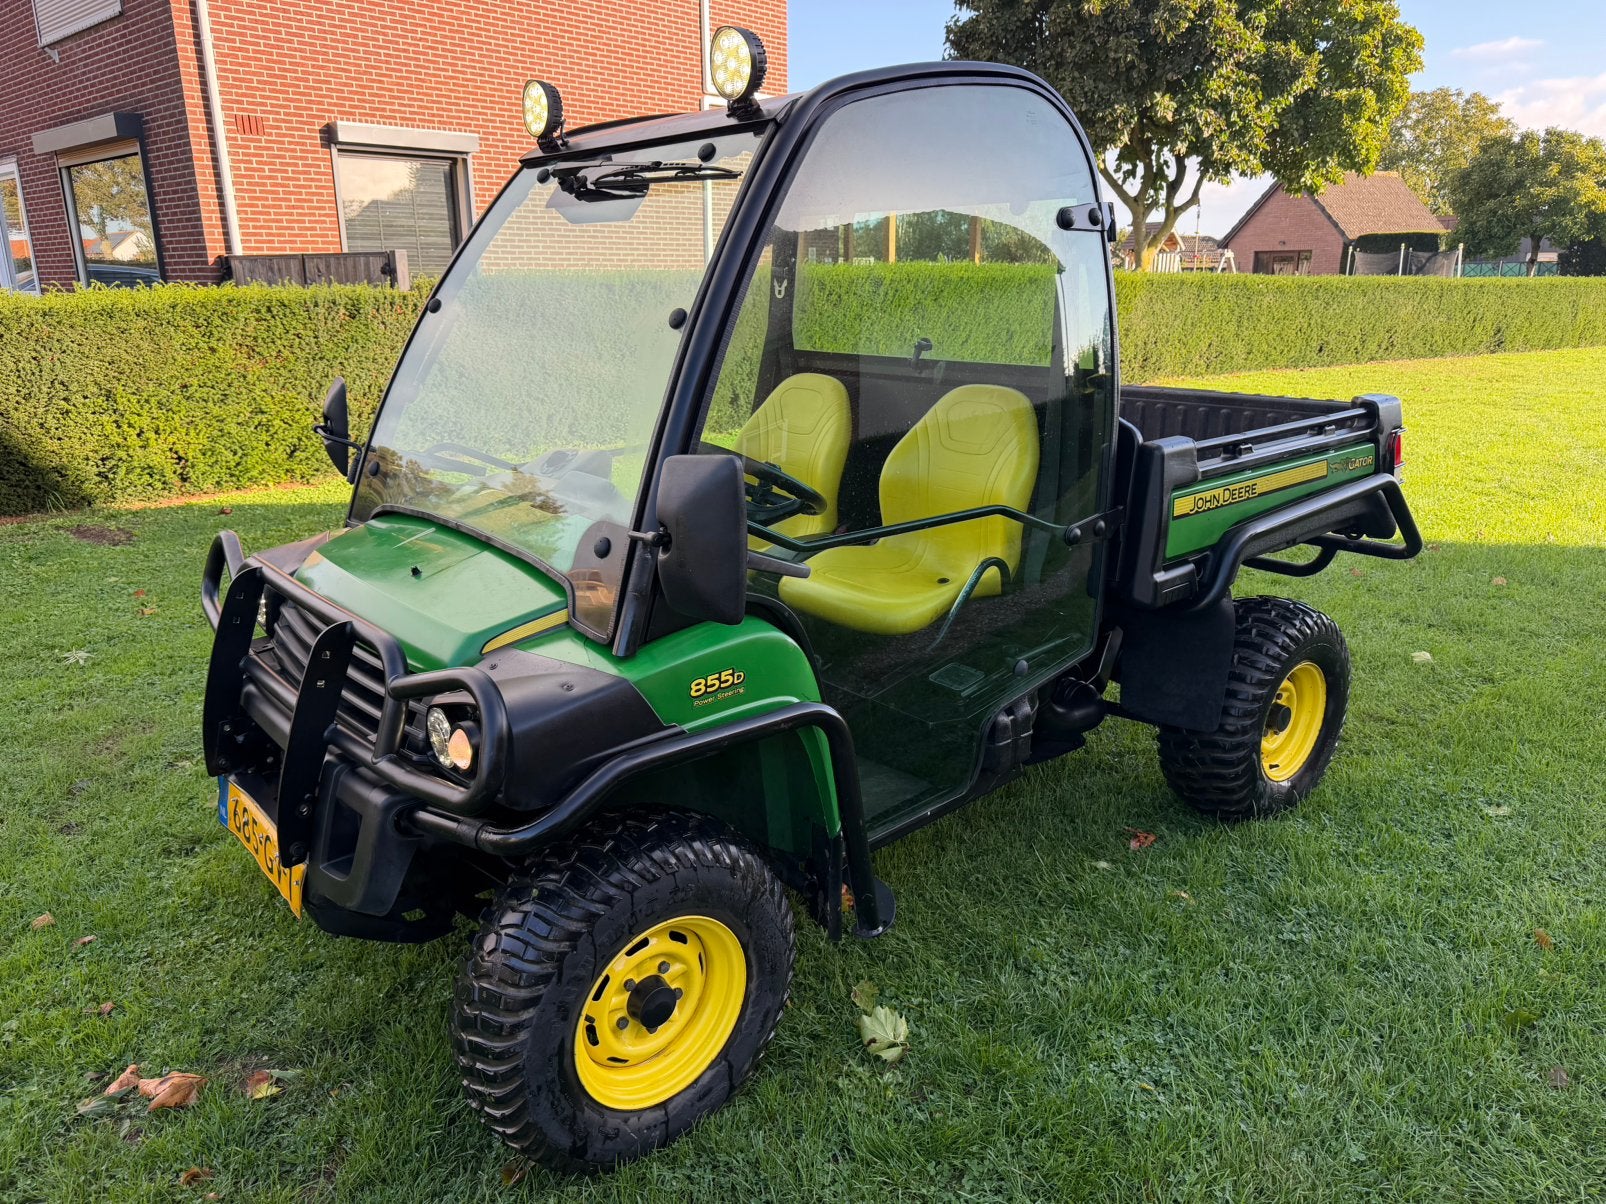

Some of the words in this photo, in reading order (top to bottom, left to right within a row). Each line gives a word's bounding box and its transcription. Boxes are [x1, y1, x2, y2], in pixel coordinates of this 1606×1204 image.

[1348, 456, 1374, 471] GATOR
[1189, 493, 1222, 514] JOHN
[1222, 482, 1258, 505] DEERE
[693, 696, 715, 707] Power
[717, 686, 745, 700] Steering
